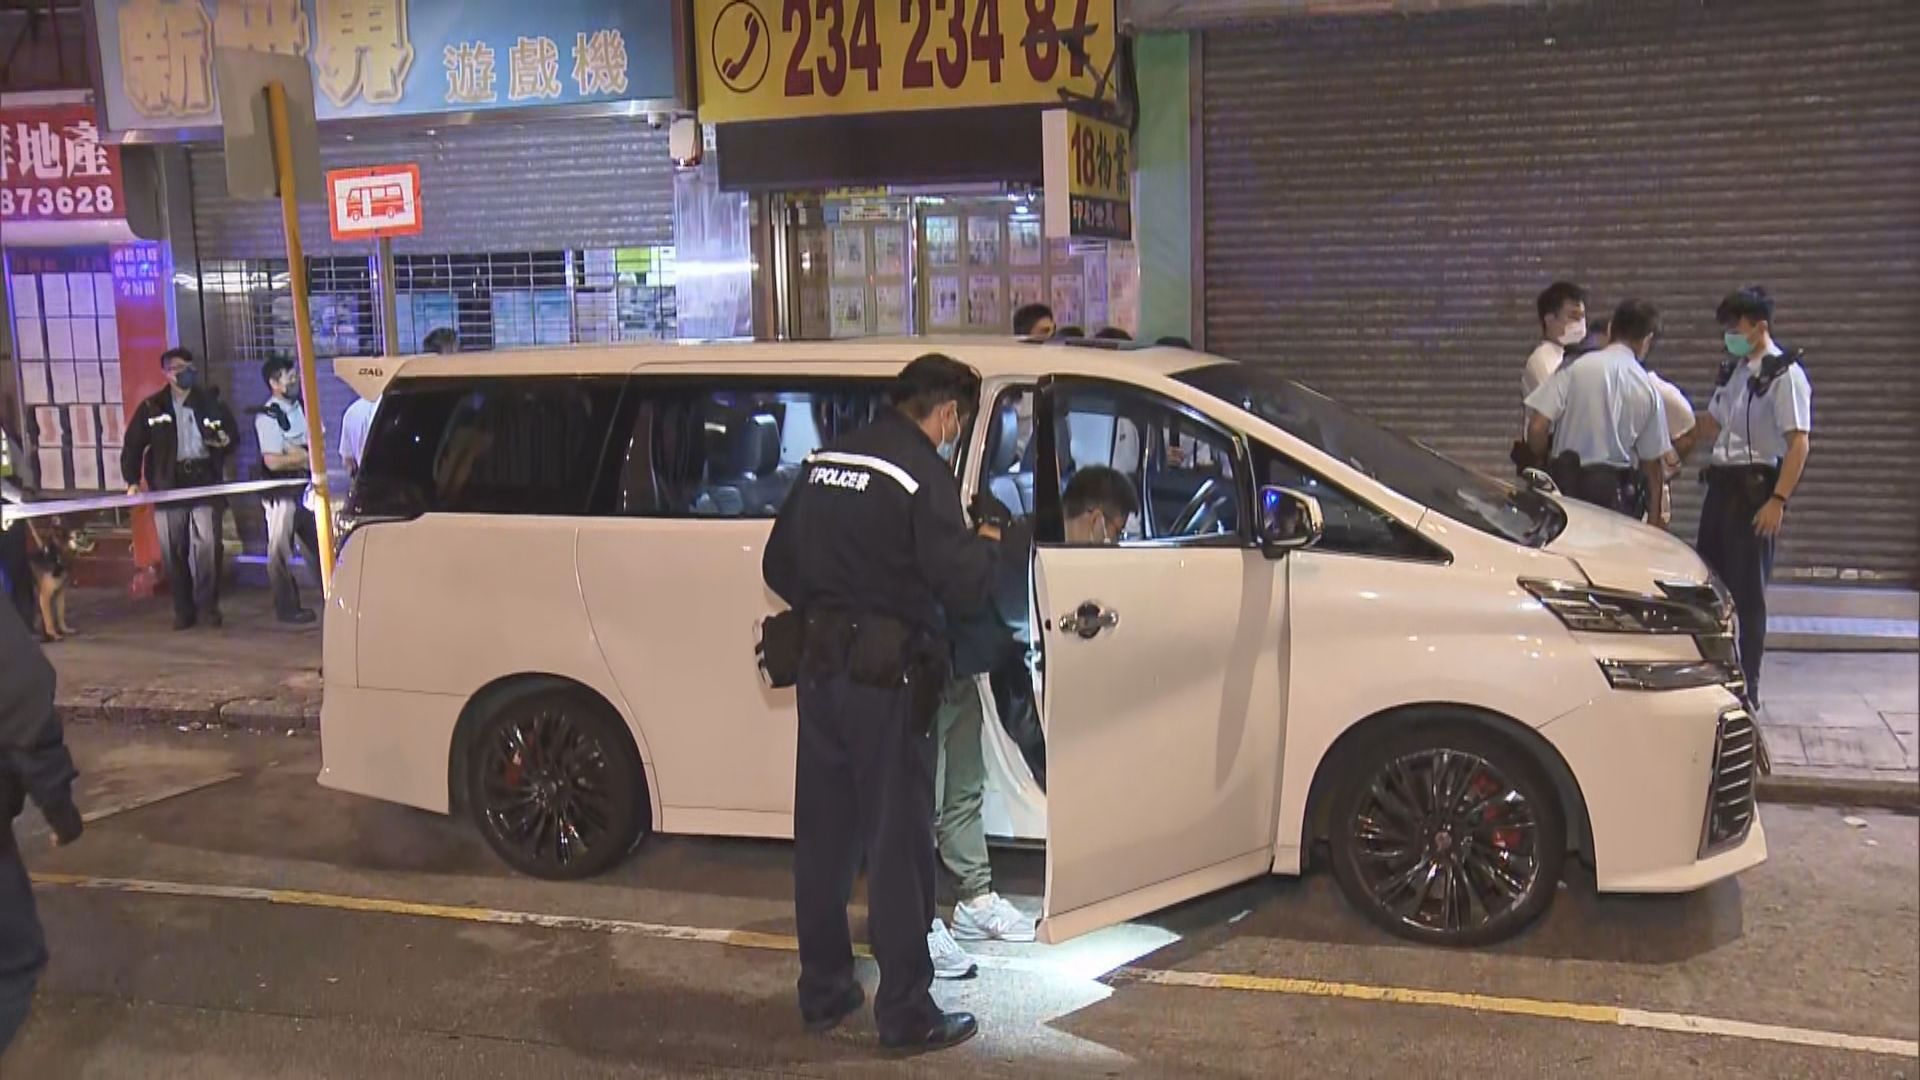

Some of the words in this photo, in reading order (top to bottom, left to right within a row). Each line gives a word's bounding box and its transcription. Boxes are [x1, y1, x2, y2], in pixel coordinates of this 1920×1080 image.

[443, 29, 629, 103] 遊戲機
[782, 0, 882, 97] 234
[900, 0, 1005, 90] 234
